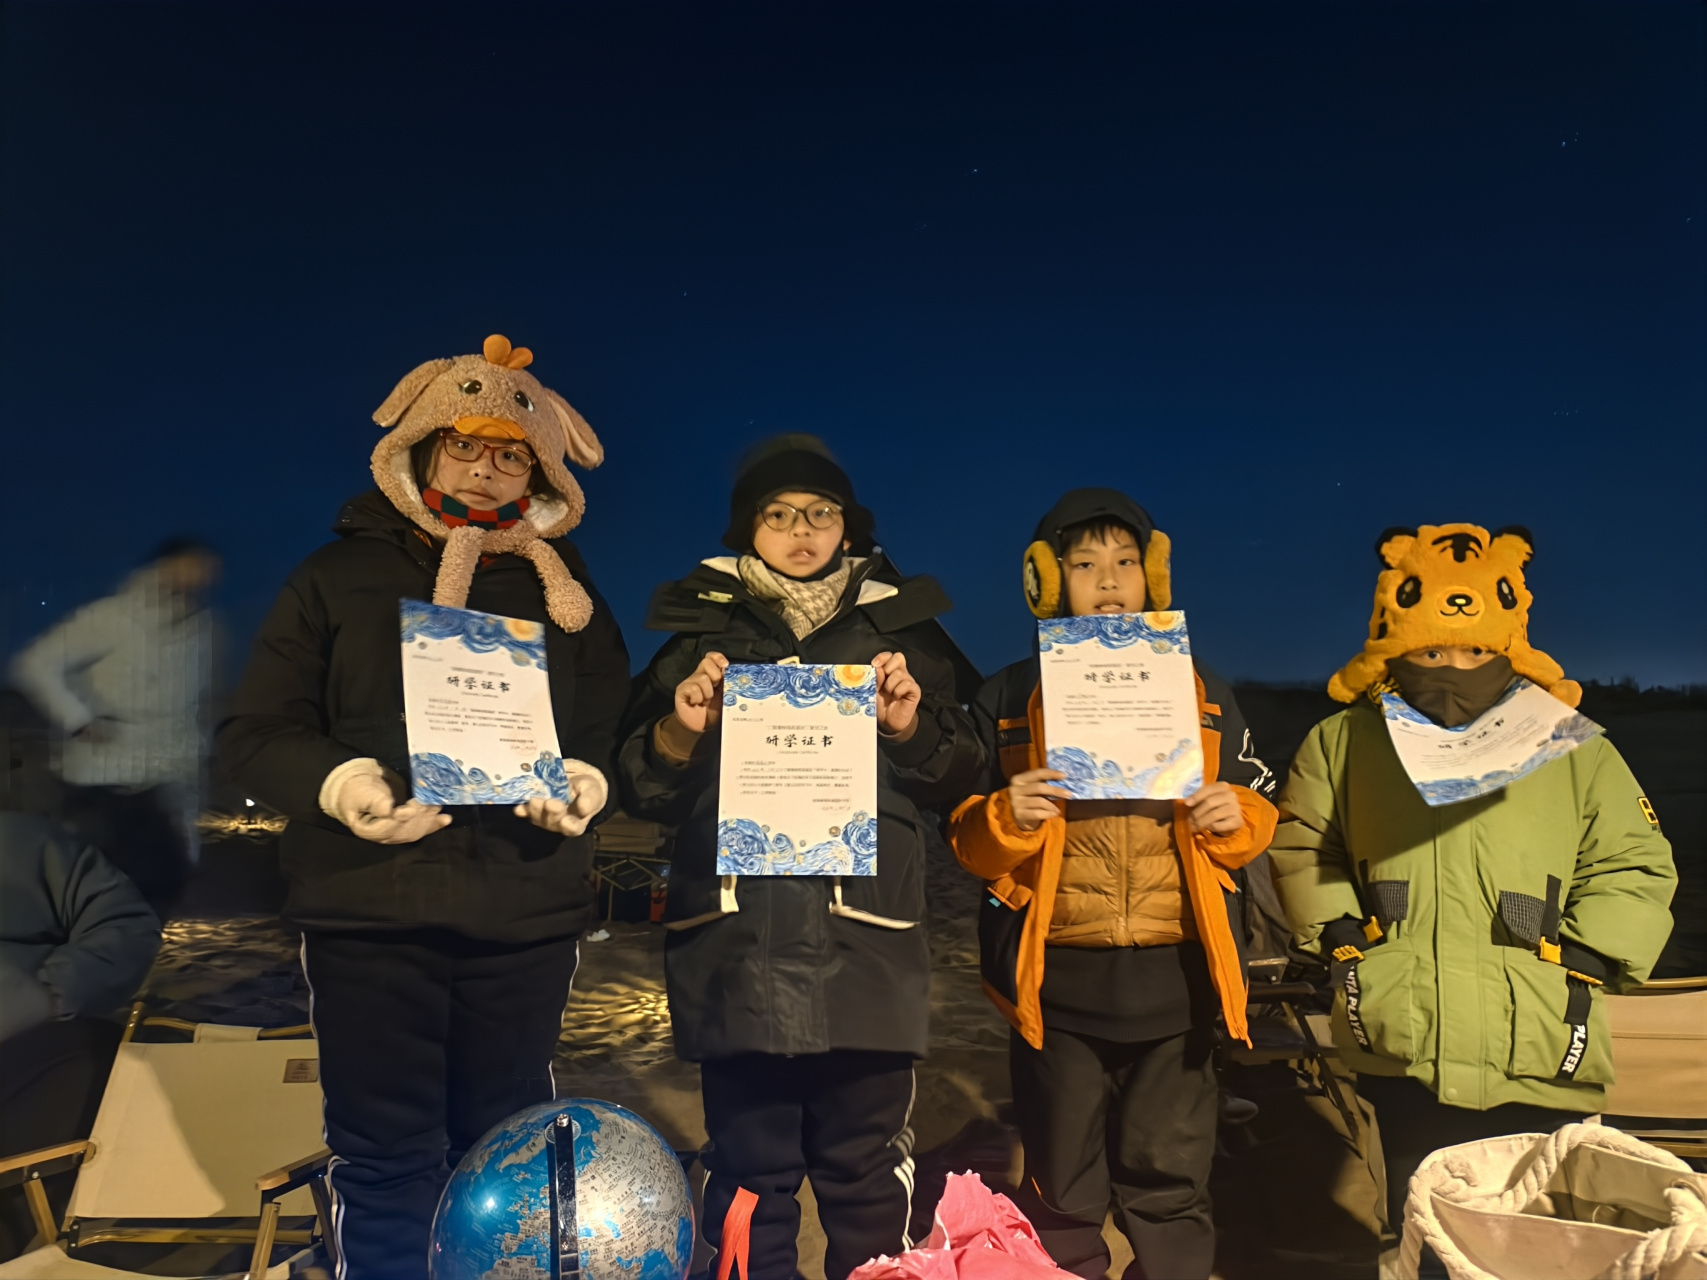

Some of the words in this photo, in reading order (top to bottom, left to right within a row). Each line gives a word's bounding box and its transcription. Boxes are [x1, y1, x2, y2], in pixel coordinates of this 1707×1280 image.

[765, 733, 834, 748] 研学证书
[1347, 996, 1368, 1046] PLAYER
[1562, 1024, 1587, 1073] PLAYER
